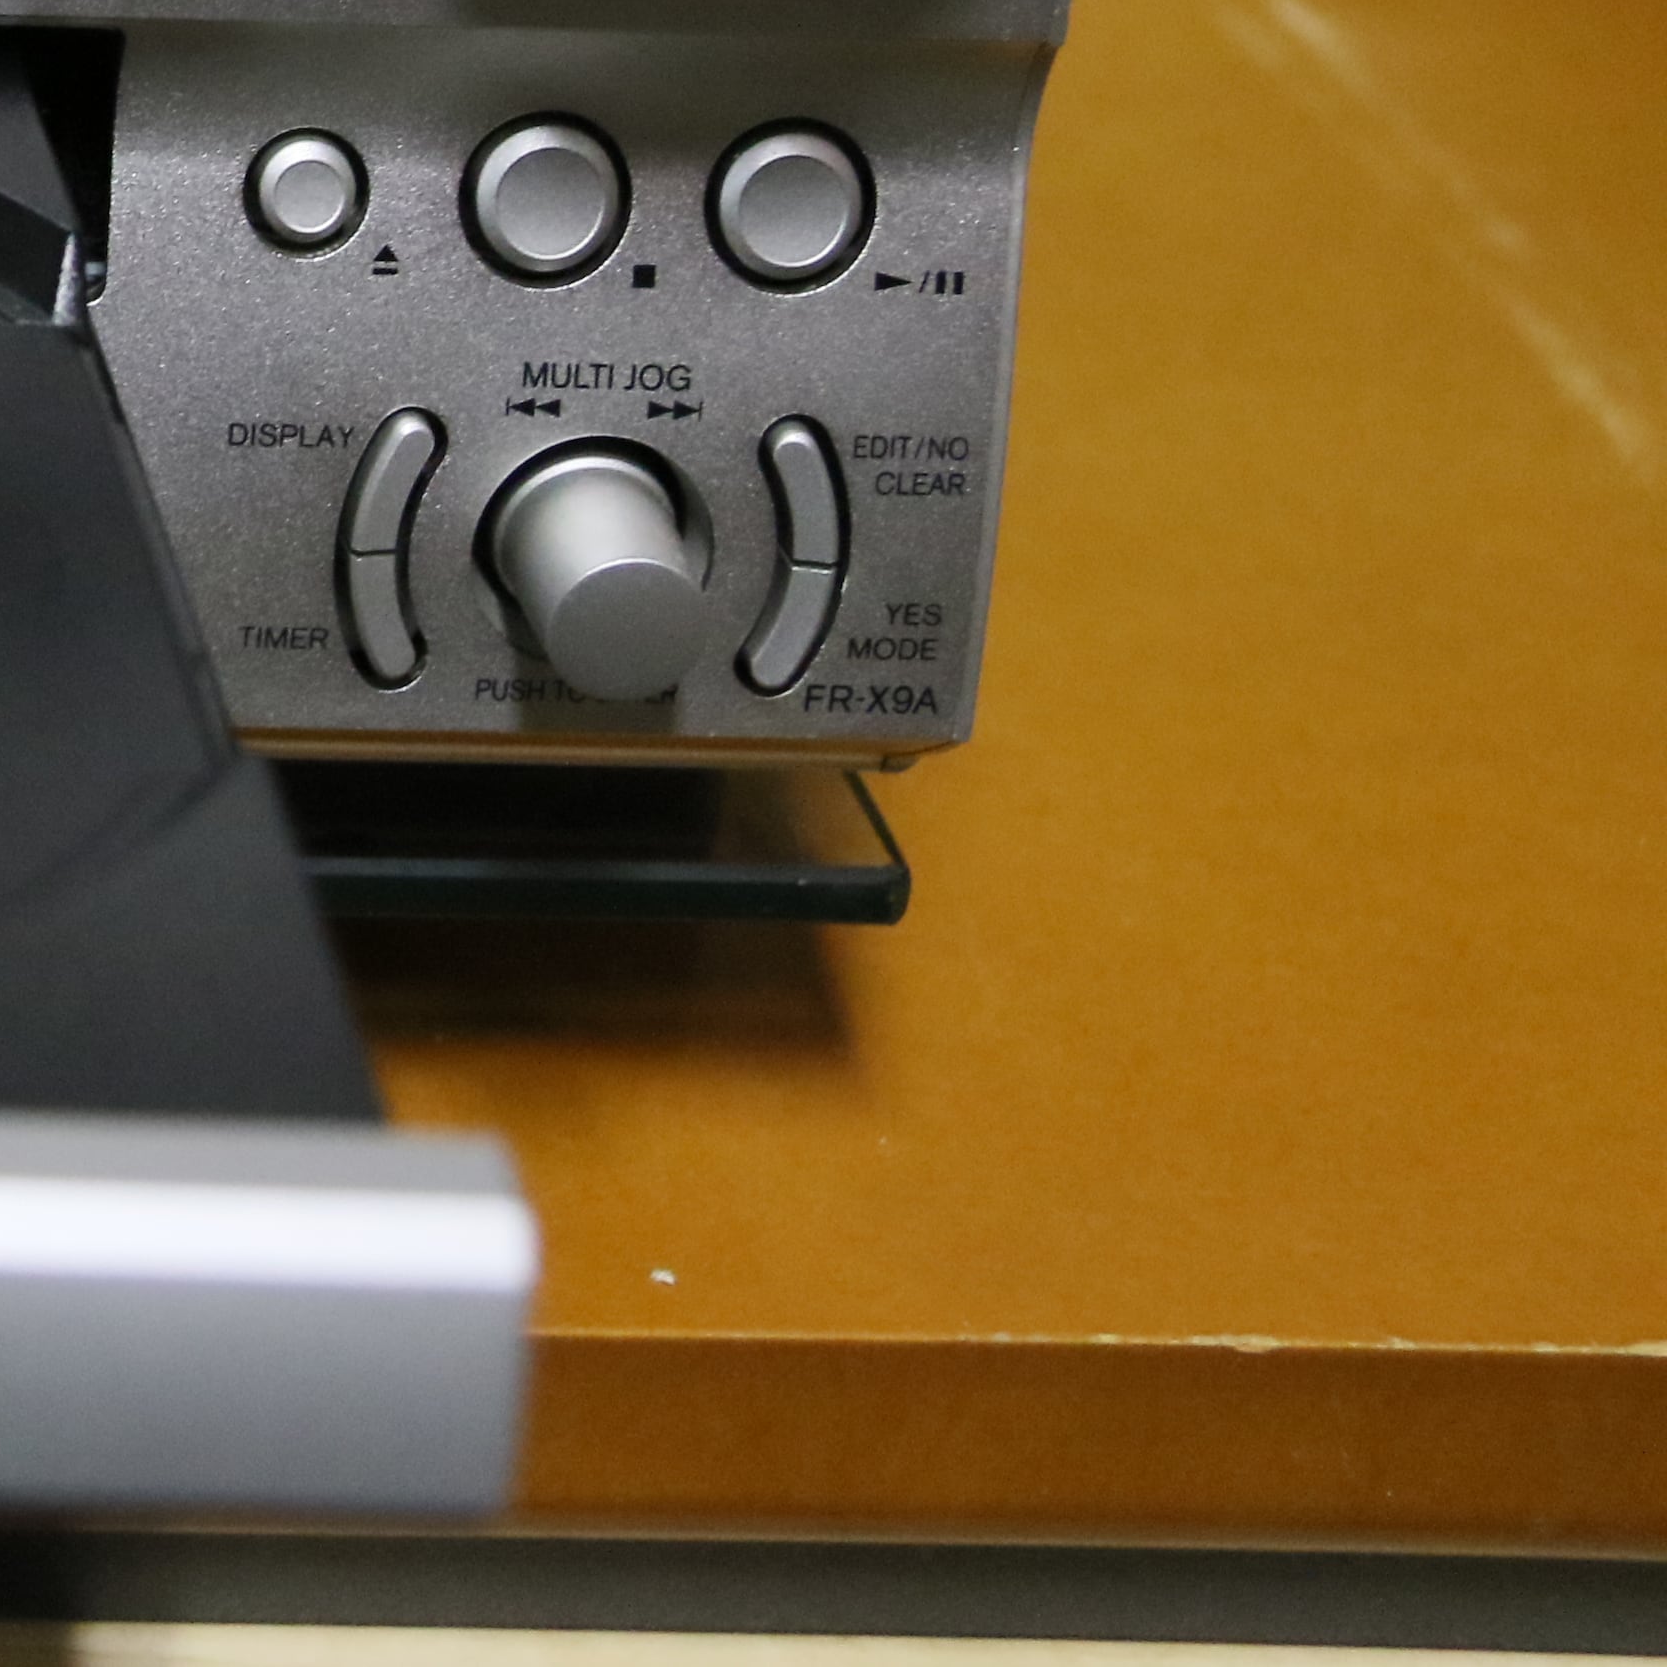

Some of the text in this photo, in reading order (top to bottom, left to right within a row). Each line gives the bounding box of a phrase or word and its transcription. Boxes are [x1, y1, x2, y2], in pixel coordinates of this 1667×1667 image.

[522, 361, 692, 393] MULTI JOG
[227, 422, 354, 449] DISPLAY
[852, 434, 970, 462] EDIT/NO
[875, 471, 966, 497] CLEAR
[887, 602, 943, 627] YES
[244, 626, 329, 650] TIMER
[848, 637, 937, 661] MODE
[473, 676, 545, 704] PUSH
[804, 684, 938, 715] FR-X9A
